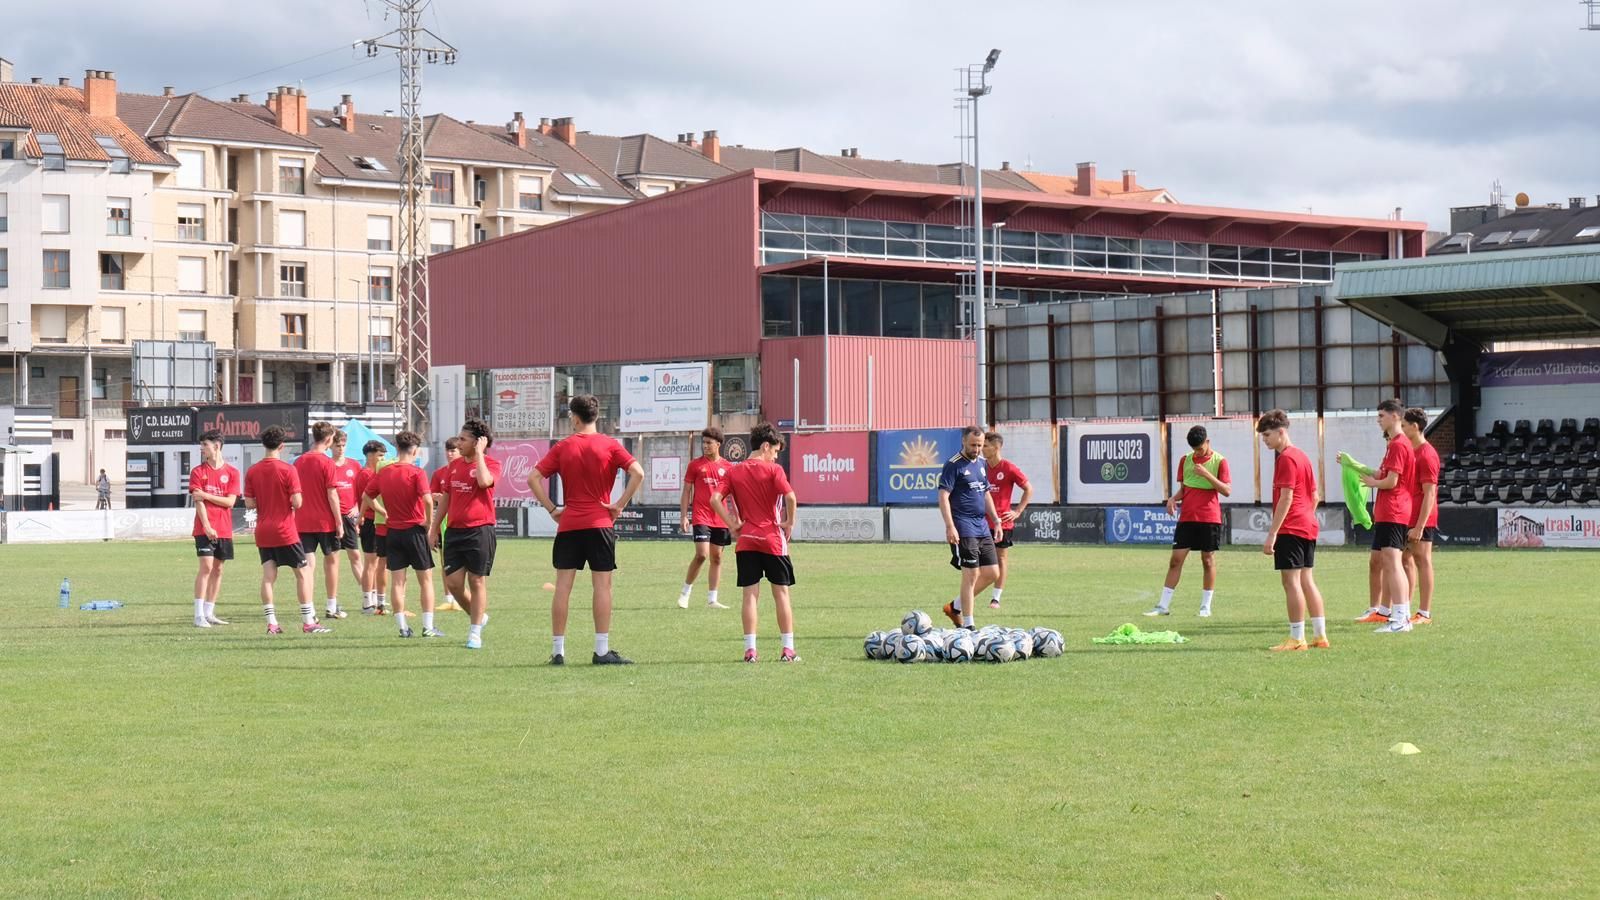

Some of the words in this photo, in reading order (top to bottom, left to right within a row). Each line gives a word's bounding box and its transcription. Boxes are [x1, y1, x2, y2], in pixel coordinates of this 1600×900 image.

[671, 376, 678, 385] la
[658, 383, 700, 395] cooperativa
[145, 415, 159, 427] C.D.
[160, 414, 190, 426] LEALTAD
[504, 412, 517, 420] 984
[518, 412, 527, 420] 29
[215, 411, 260, 440] GAITERO
[151, 430, 161, 438] LES
[161, 430, 184, 438] CALEYES
[1087, 439, 1143, 460] IMPULSO23
[802, 453, 855, 473] Mahou
[818, 474, 839, 482] SIN
[801, 519, 876, 539] NACHO
